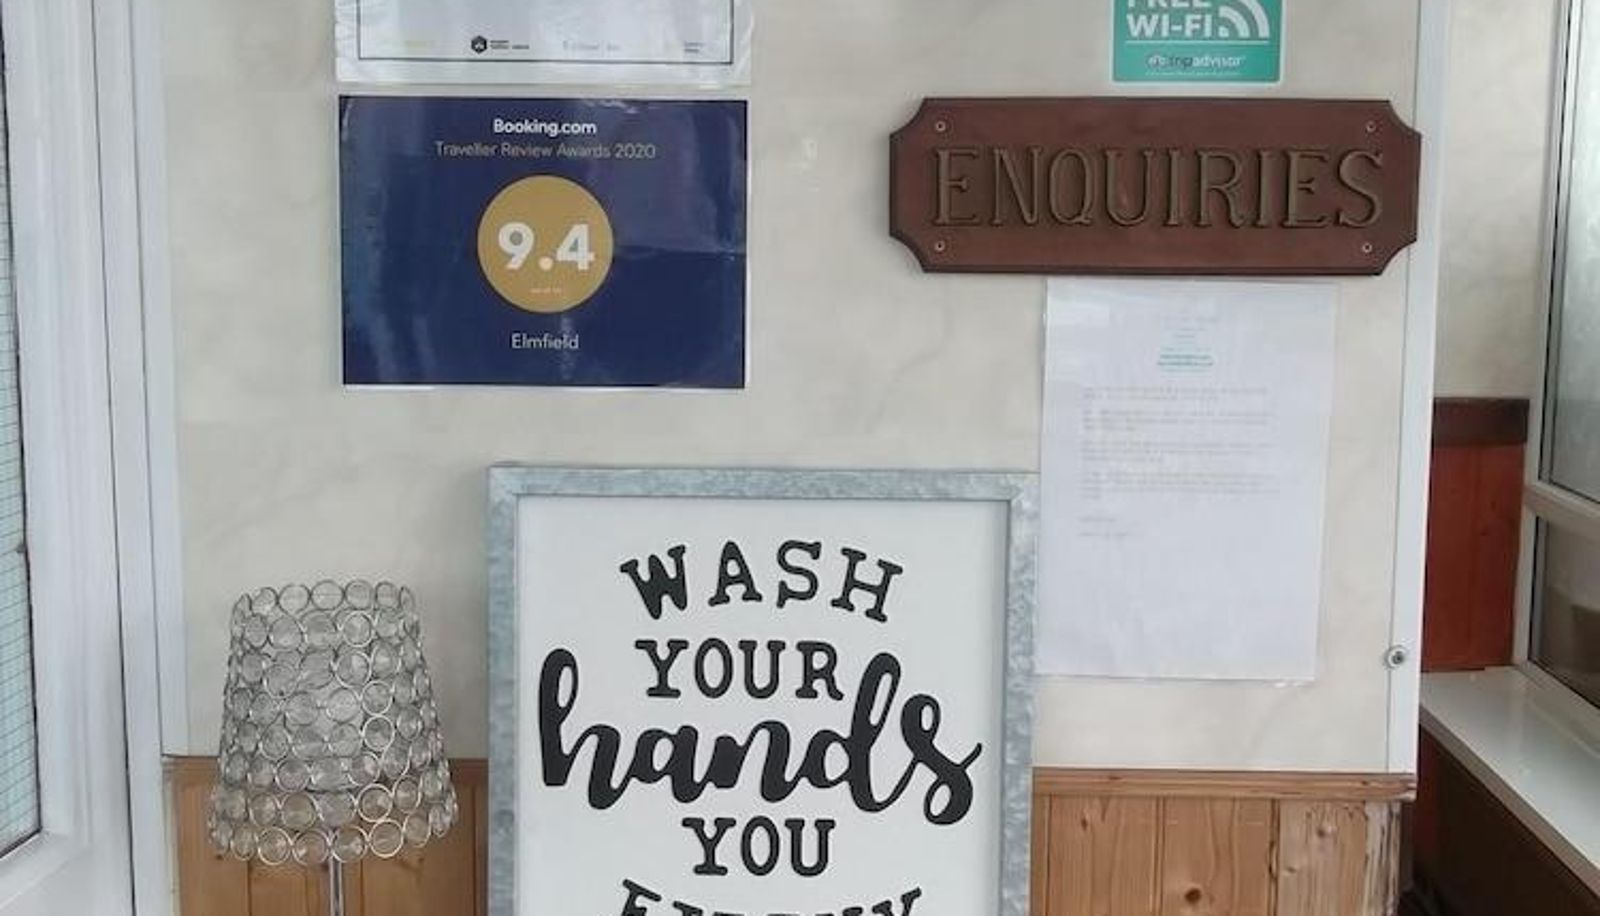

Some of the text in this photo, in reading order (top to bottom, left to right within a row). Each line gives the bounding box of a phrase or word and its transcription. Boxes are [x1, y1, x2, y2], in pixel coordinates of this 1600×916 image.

[1126, 14, 1212, 38] WI-FI
[434, 141, 656, 159] Traveller Review Awards 2020
[493, 118, 597, 137] Booking.com
[931, 144, 1386, 230] ENQUIRIES
[497, 221, 596, 271] 9.4
[510, 332, 579, 350] Elmfield
[619, 540, 903, 623] WASH
[634, 637, 844, 701] YOUR
[538, 648, 983, 826] hands
[681, 816, 836, 877] YOU
